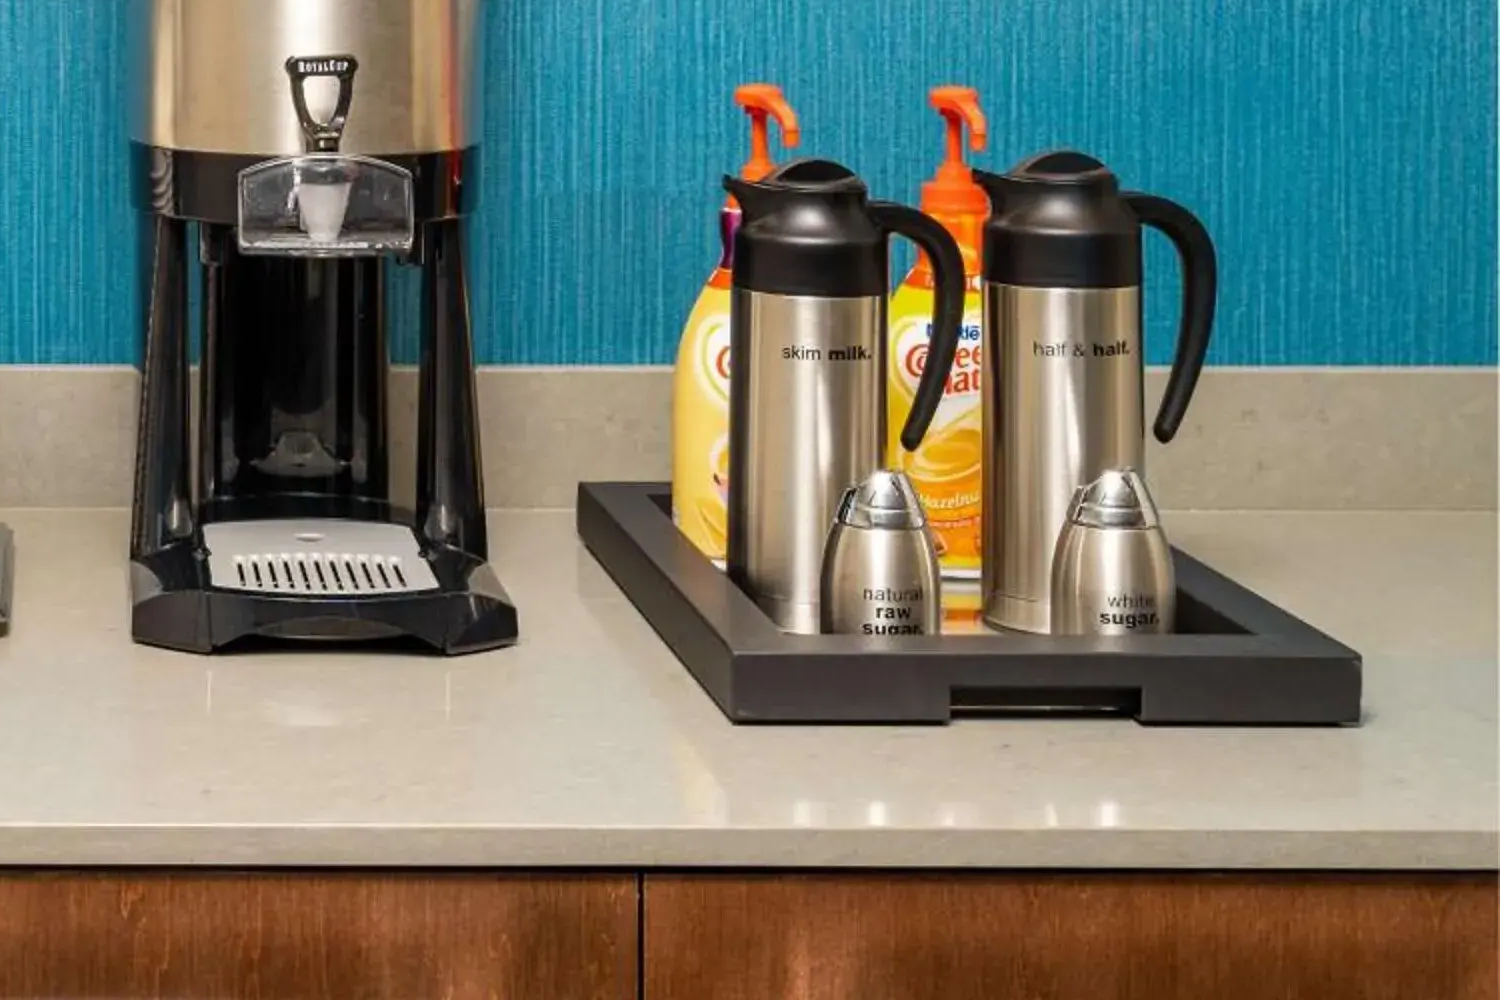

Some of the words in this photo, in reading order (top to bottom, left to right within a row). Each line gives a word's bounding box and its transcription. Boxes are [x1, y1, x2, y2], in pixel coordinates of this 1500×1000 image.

[782, 344, 821, 360] skim
[827, 344, 872, 360] milk.
[1032, 341, 1067, 357] half
[1071, 343, 1085, 357] &
[1092, 340, 1130, 357] half.
[863, 587, 923, 602] natural
[1107, 592, 1155, 608] white
[875, 607, 911, 619] raw
[1099, 613, 1160, 628] sugar.
